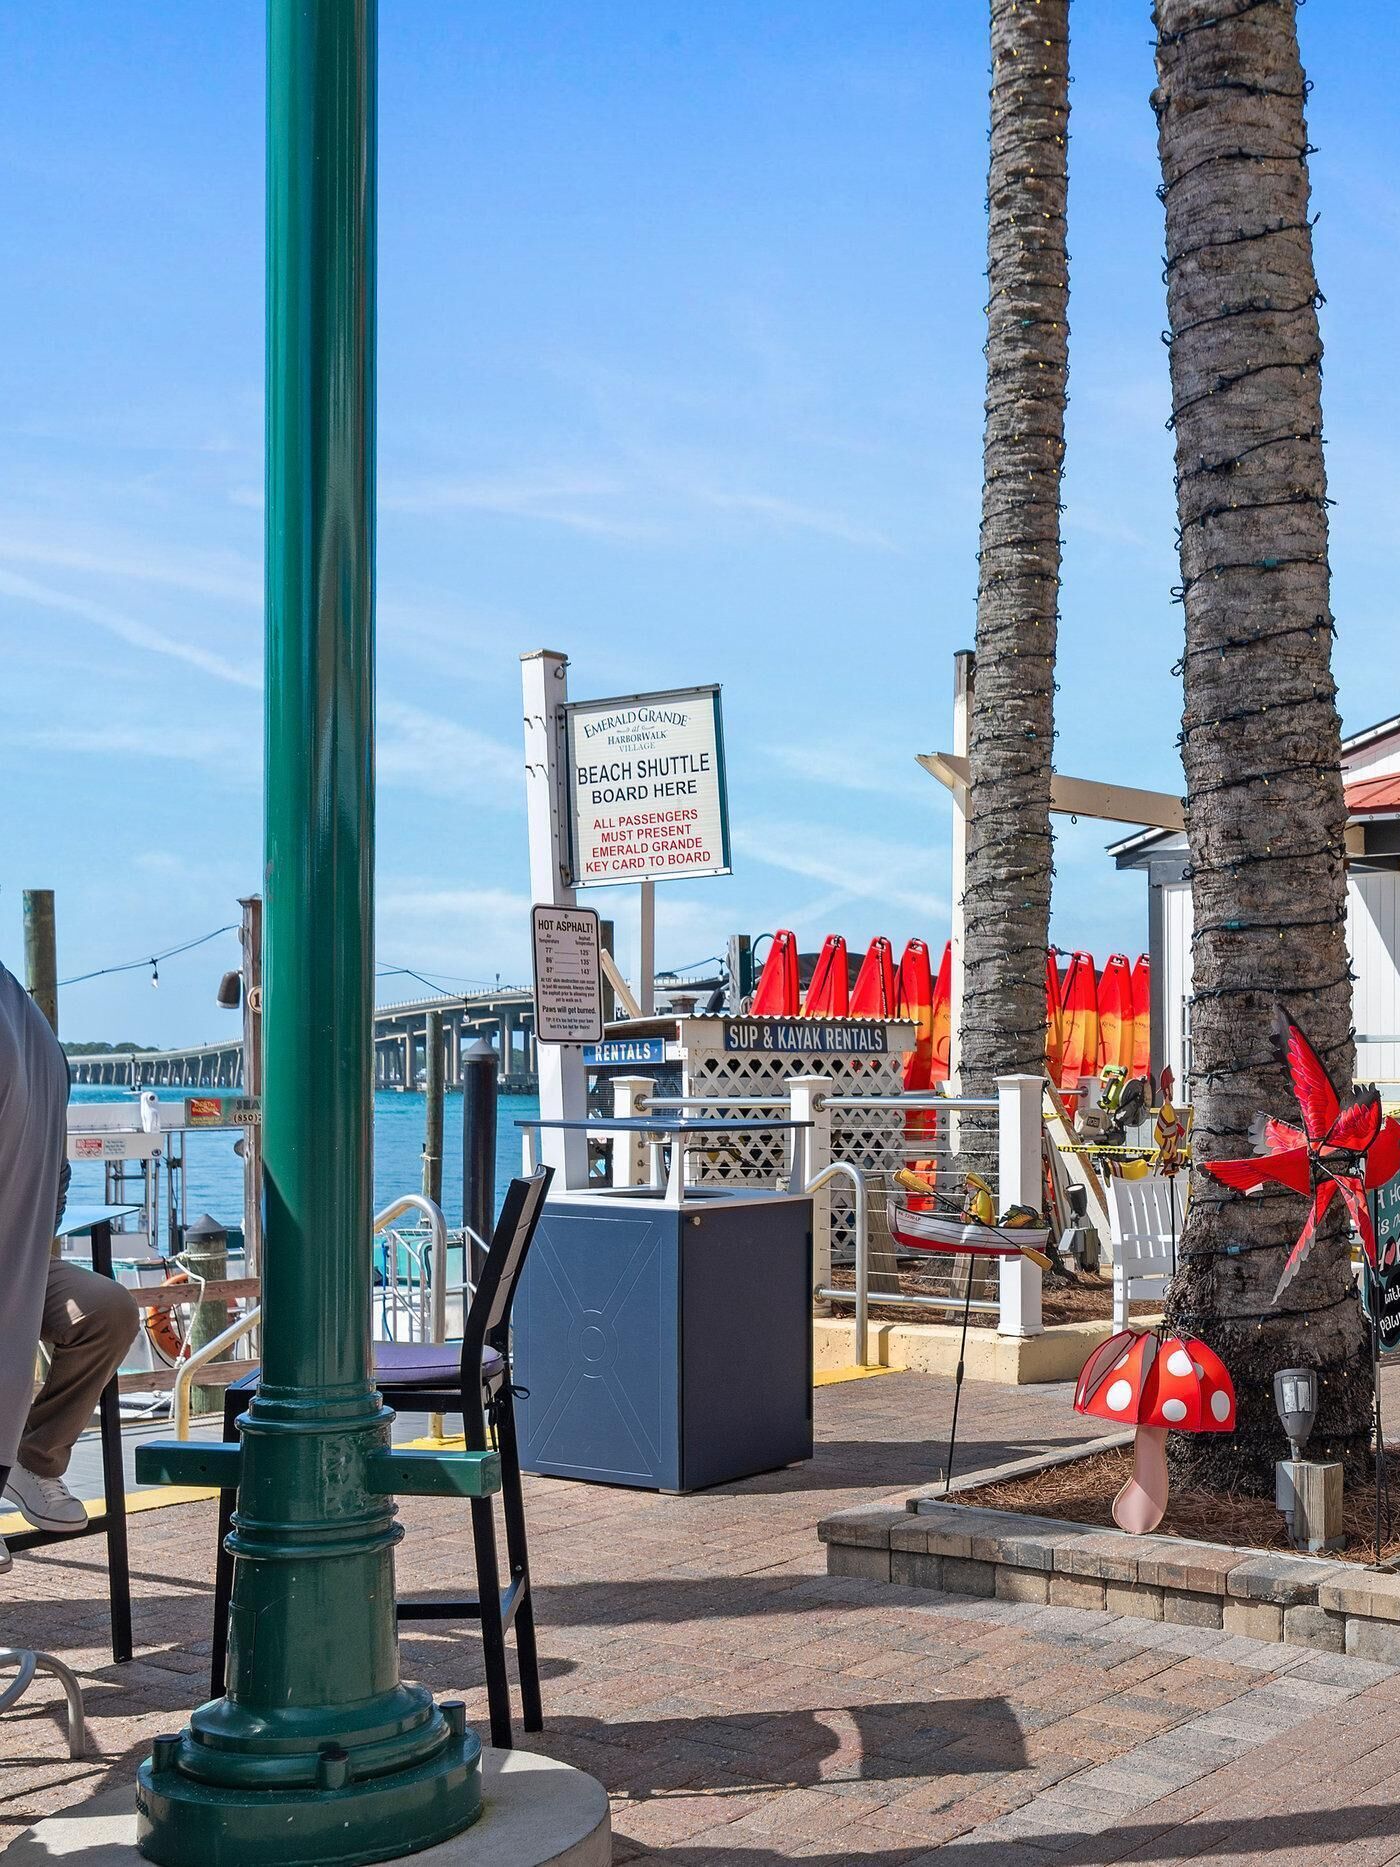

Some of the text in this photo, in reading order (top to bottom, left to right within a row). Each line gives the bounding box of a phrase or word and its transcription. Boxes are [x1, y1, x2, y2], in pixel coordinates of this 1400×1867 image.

[584, 708, 689, 738] EMERALD GRANDE
[619, 742, 656, 753] VILLAGE
[578, 752, 710, 786] BEACH SHUTTLE
[592, 780, 698, 804] BOARD HERE
[593, 809, 698, 830] ALL PASSENGERS
[600, 824, 692, 842] MUST PRESENT
[592, 837, 703, 858] EMERALD GRANDE
[586, 850, 711, 873] KEY CARD TO BOARD
[538, 920, 593, 934] HOT ASPHALT!
[729, 1025, 883, 1050] SUP & KAYAK RENTALS
[595, 1042, 651, 1062] RENTALS
